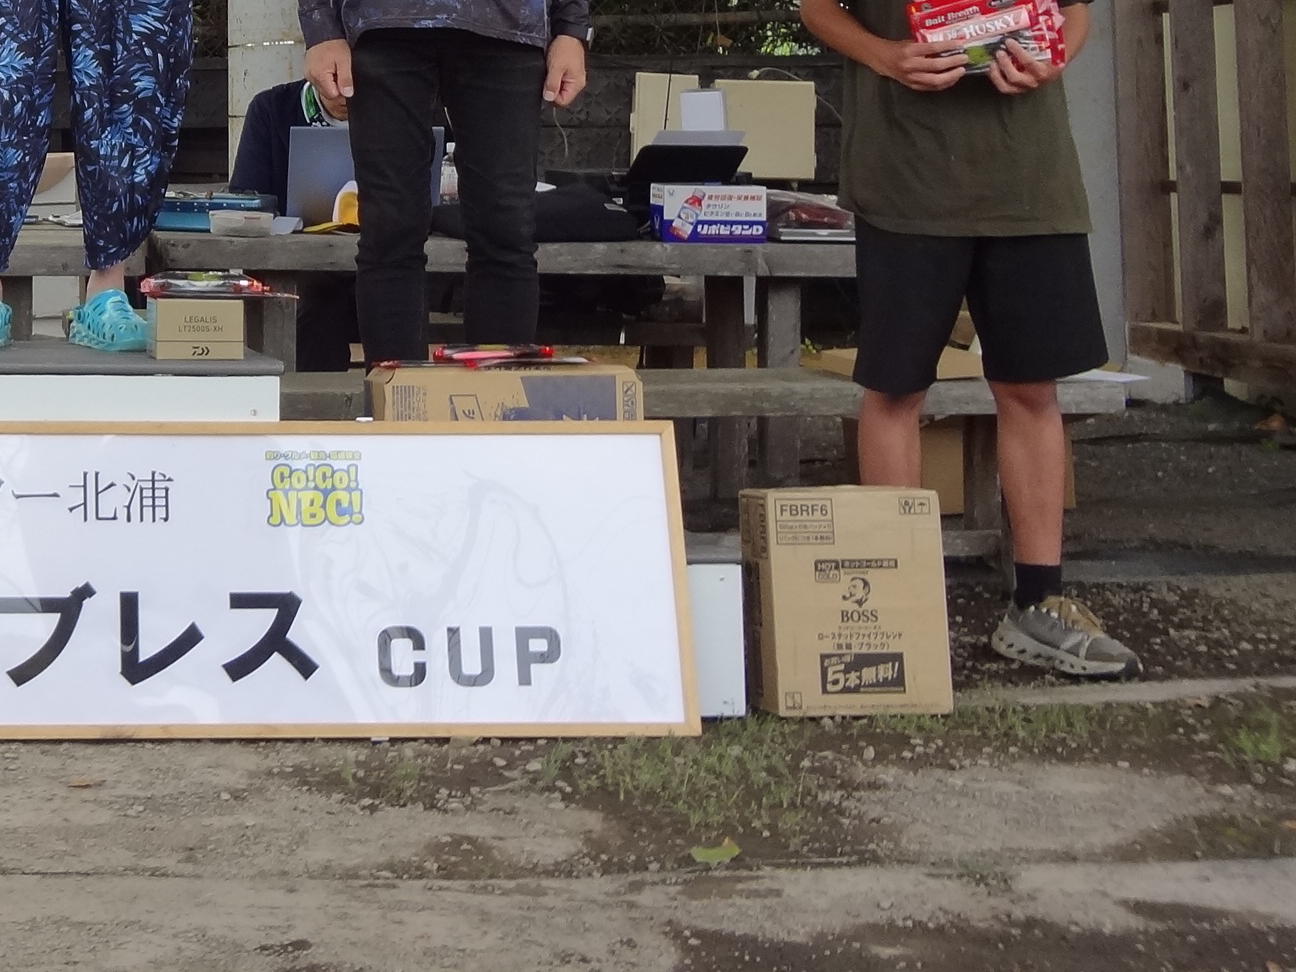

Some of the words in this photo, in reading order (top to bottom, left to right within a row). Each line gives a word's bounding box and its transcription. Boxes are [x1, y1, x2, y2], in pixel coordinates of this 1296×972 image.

[925, 15, 946, 27] Bait
[964, 14, 1015, 38] HUSKY
[697, 223, 764, 235] リポビタンD
[178, 325, 224, 333] LT2500S-XH
[266, 488, 365, 527] NBC!
[780, 504, 828, 516] FBRF6
[840, 609, 879, 623] BOSS
[377, 625, 562, 688] CUP
